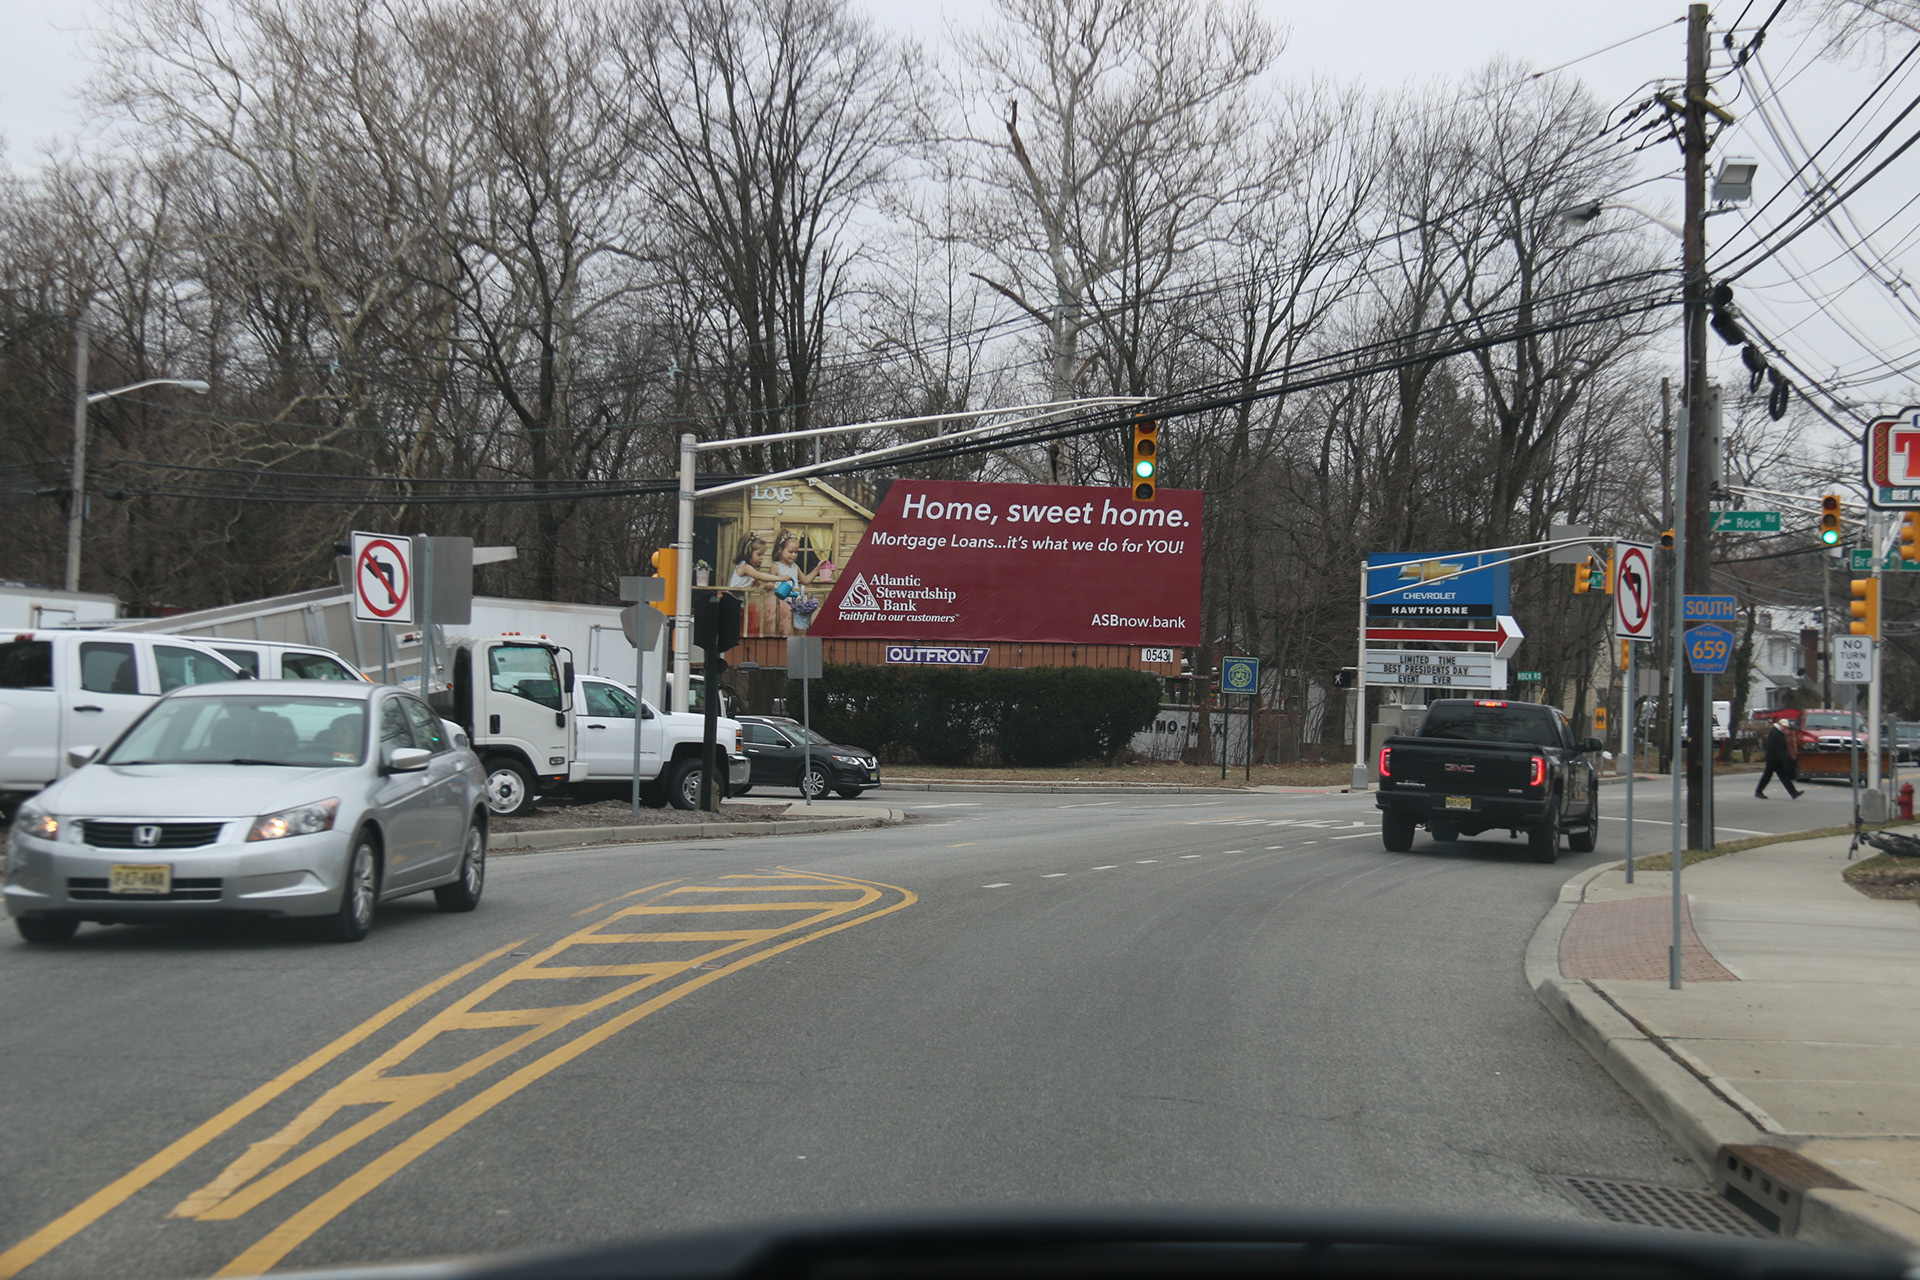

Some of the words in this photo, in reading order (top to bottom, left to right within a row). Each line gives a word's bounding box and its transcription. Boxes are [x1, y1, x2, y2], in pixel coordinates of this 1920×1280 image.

[902, 493, 998, 526] Home,
[1006, 502, 1094, 525] sweet
[1100, 498, 1190, 528] home.
[1736, 517, 1762, 529] Rock
[1765, 514, 1776, 523] Rd
[871, 531, 947, 551] Mortgage
[1032, 535, 1069, 551] what
[1072, 541, 1094, 551] we
[1097, 537, 1118, 553] do
[1121, 538, 1144, 553] for
[1145, 539, 1185, 555] YOU!
[869, 573, 921, 587] Atlantic
[876, 586, 957, 604] Stewardship
[1402, 592, 1457, 600] CHEVROLET
[882, 599, 918, 612] Bank
[1391, 606, 1469, 615] HAWTHORNE
[1685, 601, 1733, 616] SOUTH
[838, 611, 876, 624] Faithful
[878, 613, 887, 622] to
[1091, 613, 1186, 629] ASBnow.bank
[1692, 640, 1727, 660] 659
[1843, 640, 1863, 649] NO
[889, 647, 984, 663] OUTFRONT
[1146, 649, 1169, 661] 0543
[1400, 655, 1430, 664] LIMITED
[1438, 656, 1456, 665] TIME
[1840, 651, 1867, 660] TURN
[1383, 664, 1402, 673] BEST
[1404, 665, 1450, 675] PRESIDENTS
[1452, 666, 1469, 675] DAY
[1846, 661, 1860, 670] ON
[1398, 674, 1420, 683] EVENT
[1432, 675, 1452, 685] EVER
[1843, 671, 1863, 680] RED
[1444, 763, 1475, 772] GMC
